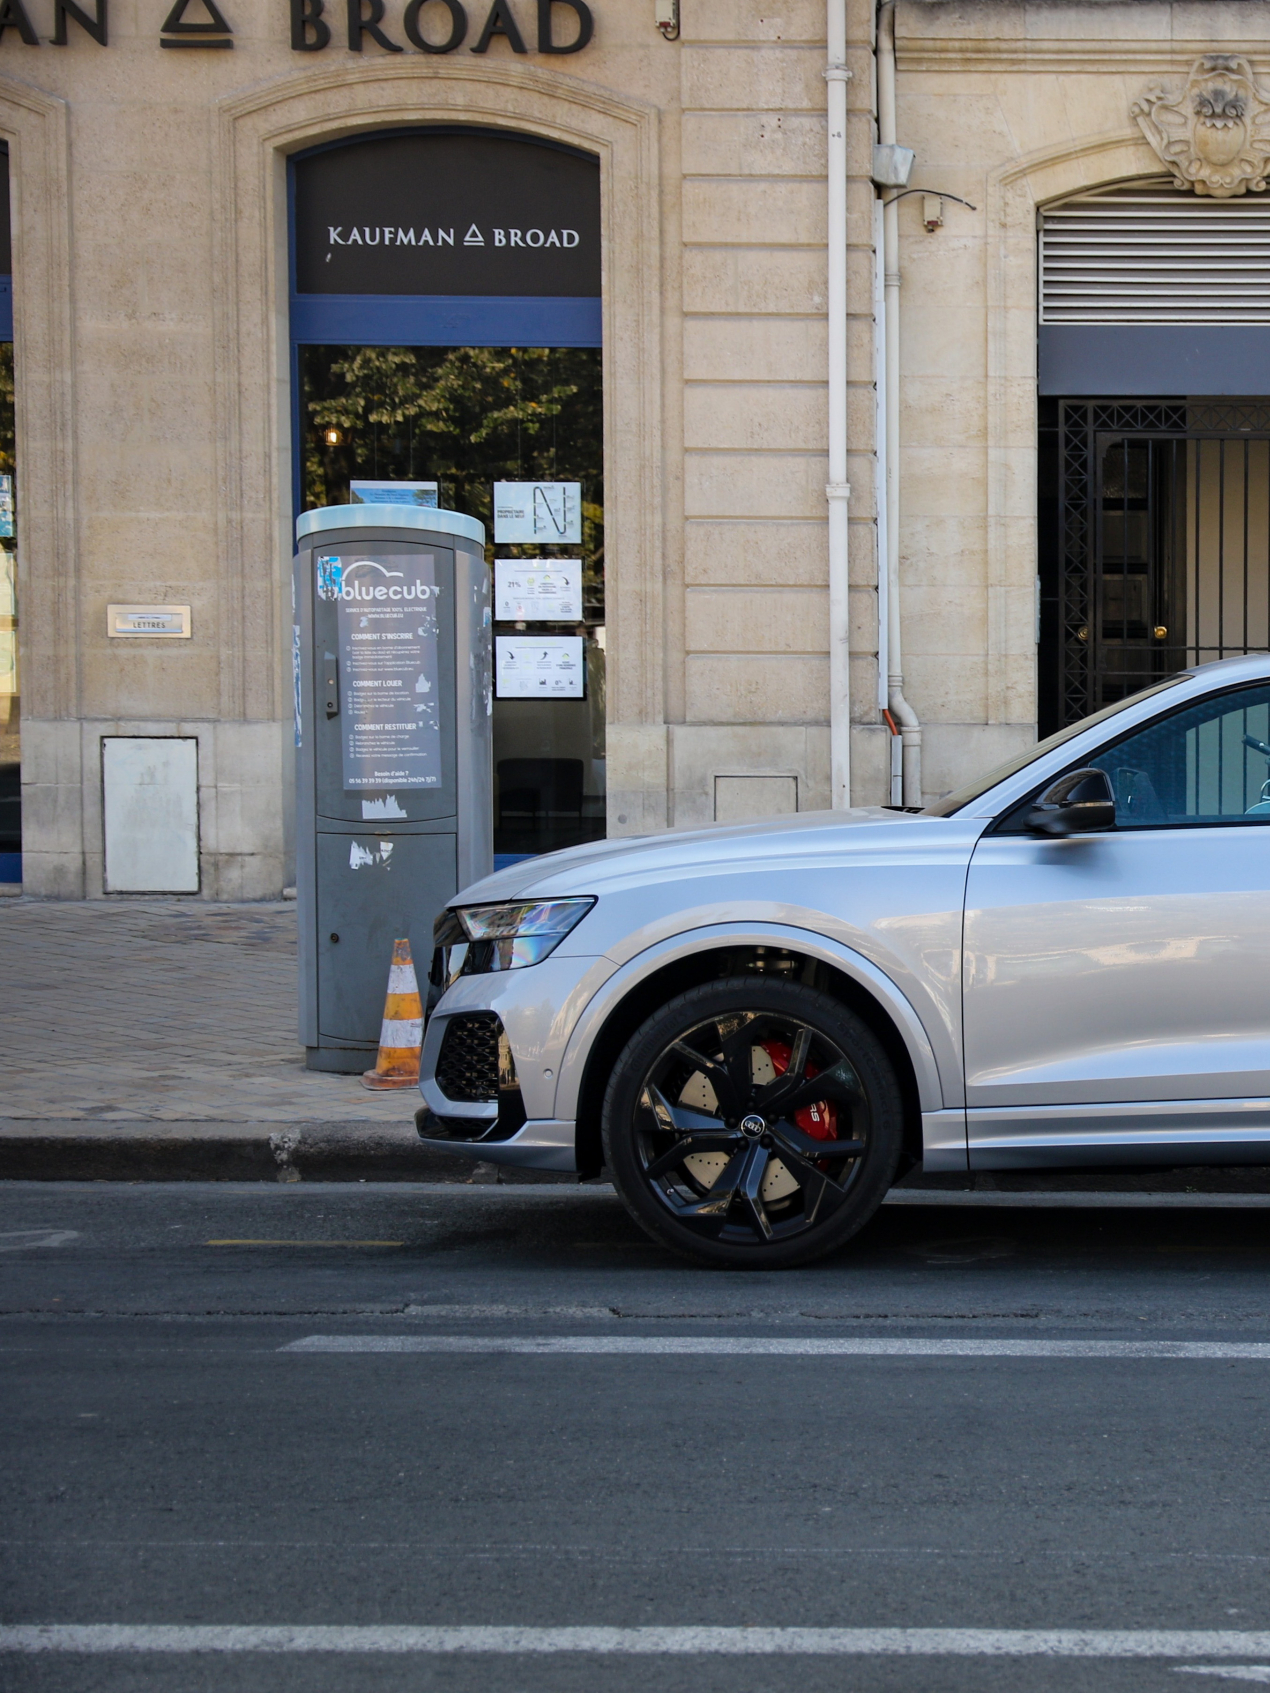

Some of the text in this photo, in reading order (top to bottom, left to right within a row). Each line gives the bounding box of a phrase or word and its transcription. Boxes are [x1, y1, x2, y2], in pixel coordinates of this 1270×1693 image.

[290, 0, 595, 54] BROAD
[328, 226, 580, 248] KAUFMAN BROAD
[342, 580, 431, 600] bluecub
